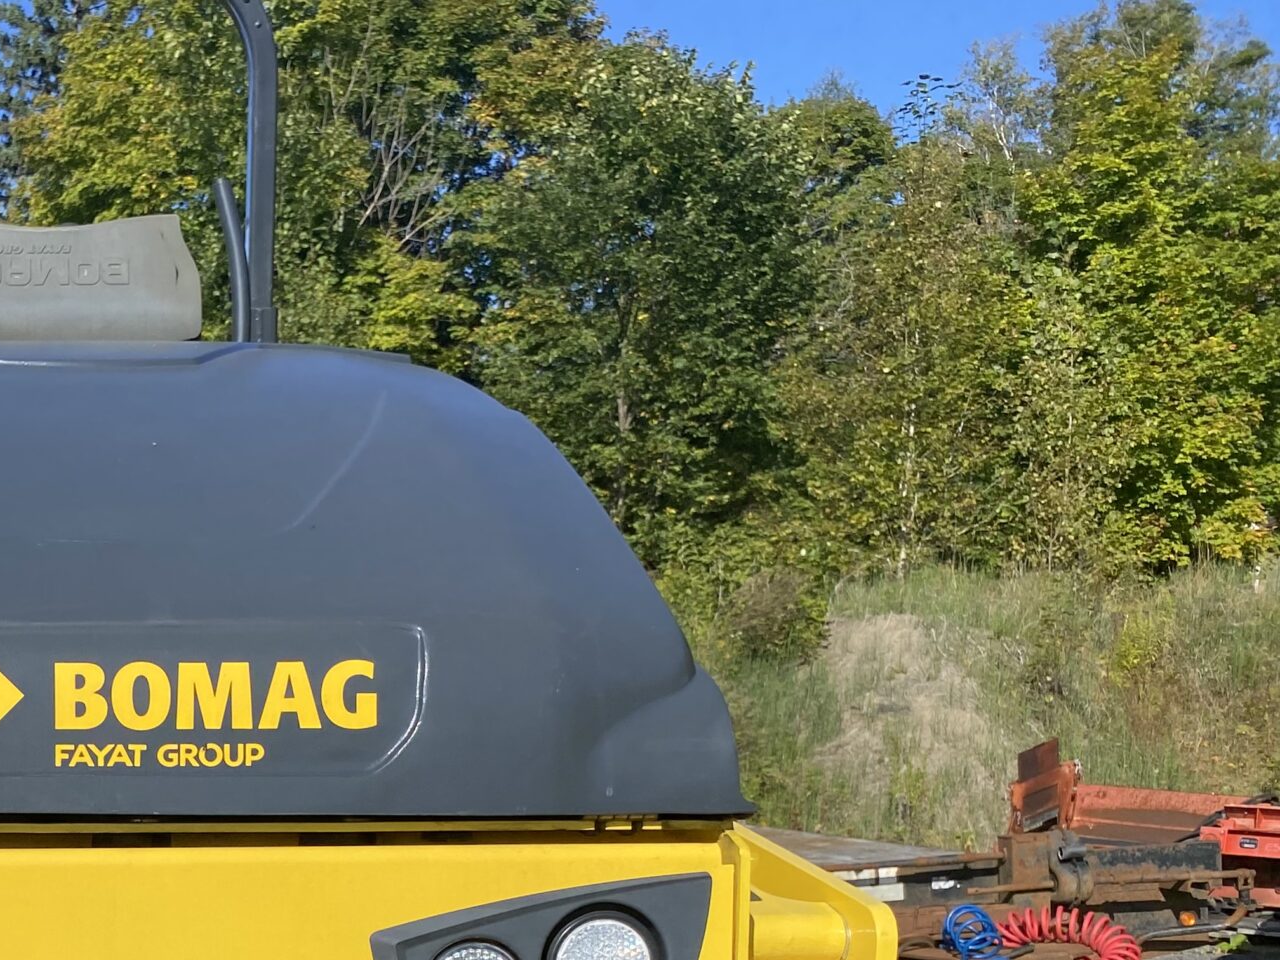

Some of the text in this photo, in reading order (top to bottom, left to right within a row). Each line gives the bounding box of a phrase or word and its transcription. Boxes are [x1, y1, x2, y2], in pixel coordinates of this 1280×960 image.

[54, 659, 378, 731] BOMAG
[54, 742, 266, 768] FAYAT GROUP
